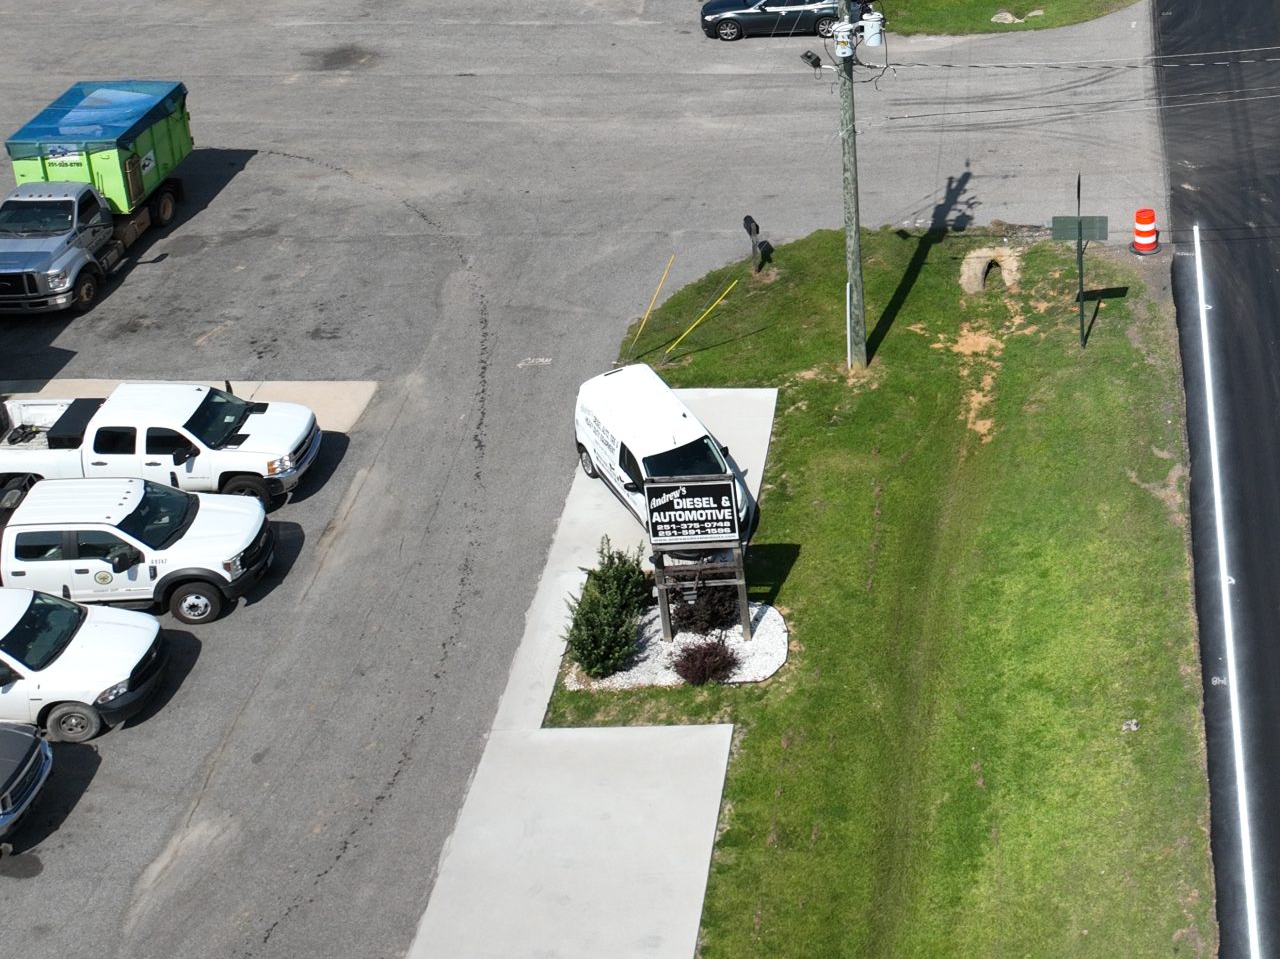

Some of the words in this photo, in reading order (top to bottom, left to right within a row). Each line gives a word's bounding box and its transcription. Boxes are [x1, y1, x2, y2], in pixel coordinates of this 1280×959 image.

[650, 486, 687, 510] Andrew's
[673, 497, 718, 510] DIESEL
[721, 496, 731, 508] &
[652, 509, 733, 523] AUTOMOTIVE
